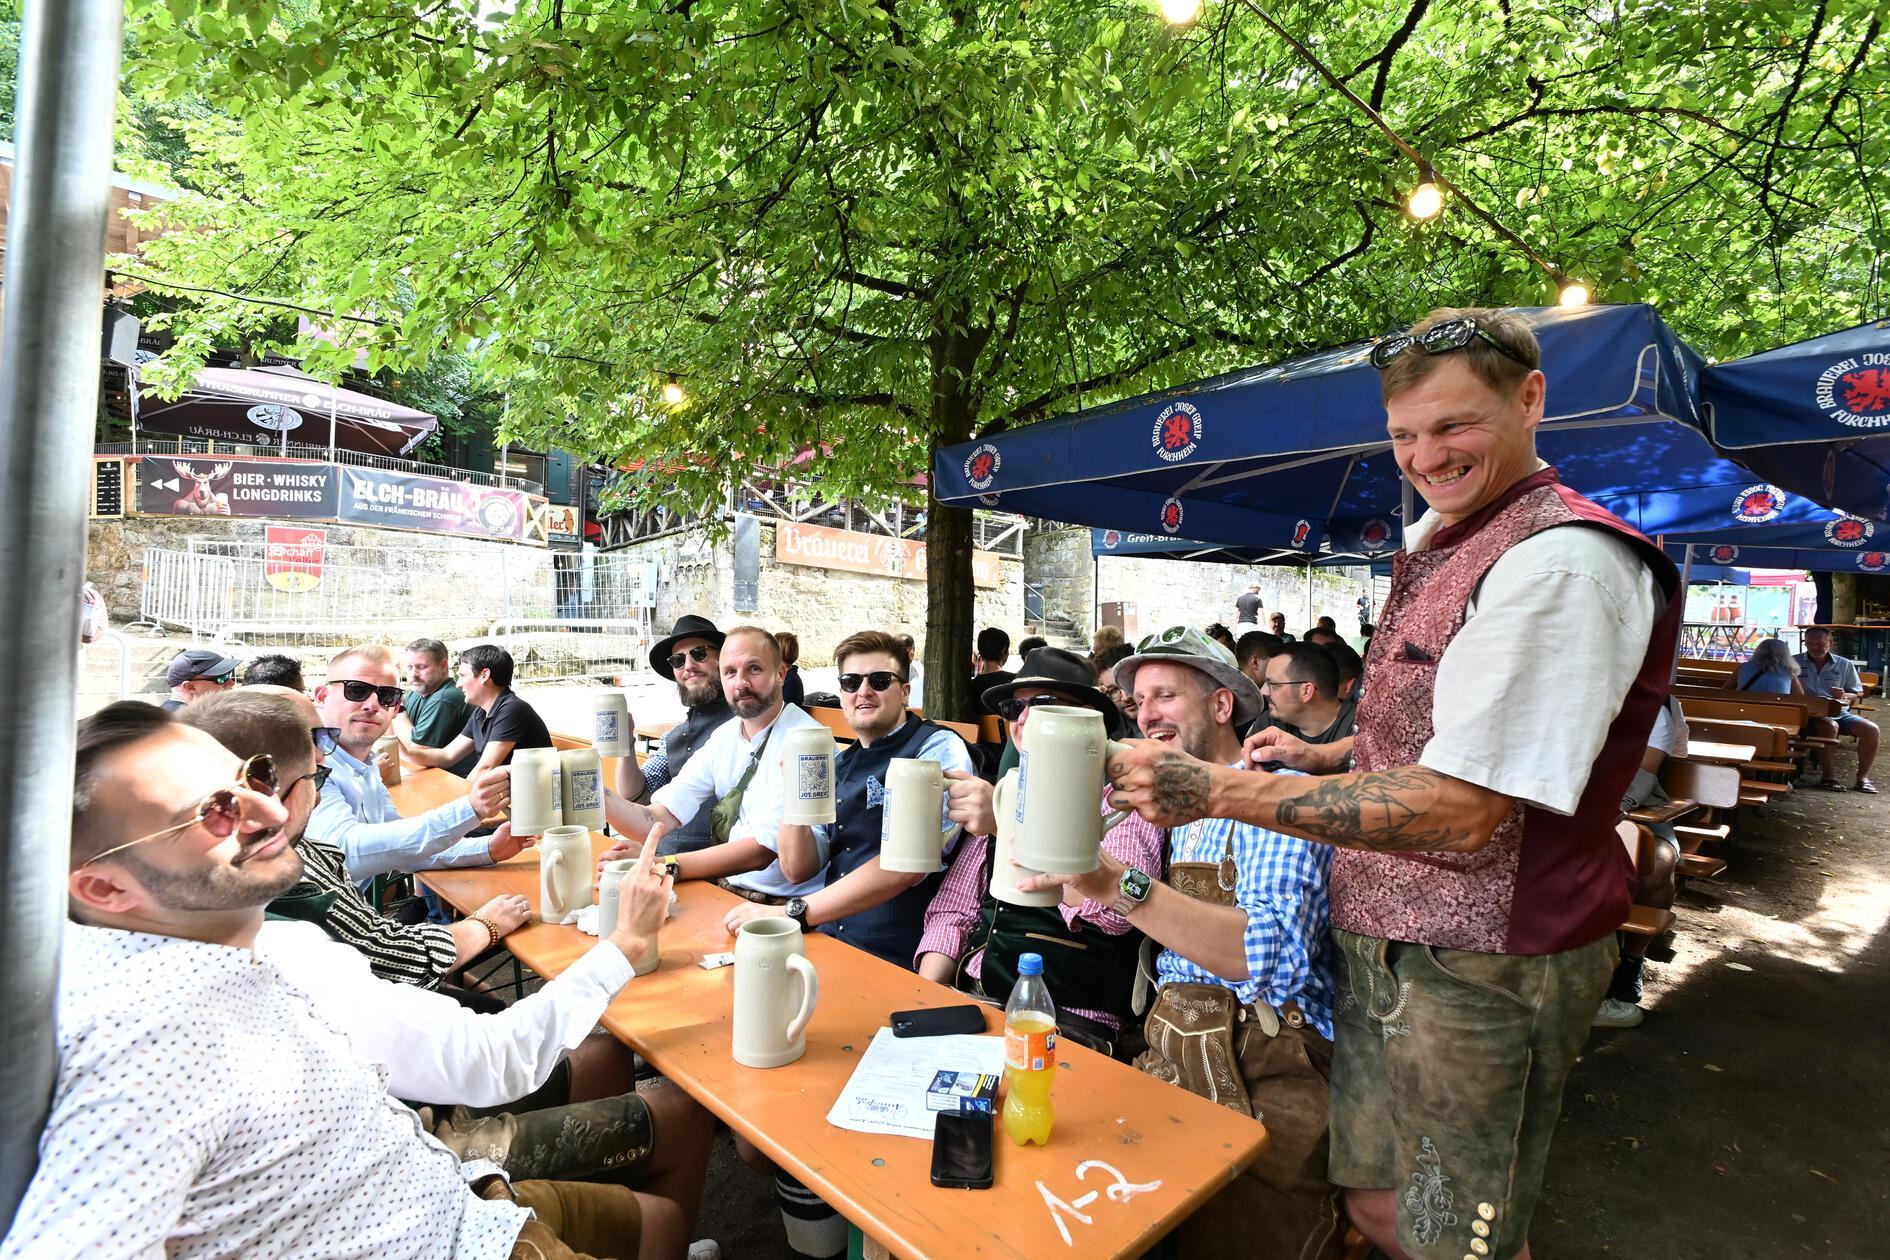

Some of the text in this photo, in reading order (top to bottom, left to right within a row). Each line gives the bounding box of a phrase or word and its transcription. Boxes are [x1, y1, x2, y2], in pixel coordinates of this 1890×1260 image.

[1816, 353, 1890, 410] BRAUEREI JOS
[1152, 402, 1202, 447] BRAUEREI JOSEF GREIF
[1829, 409, 1890, 428] FORCHH
[1157, 442, 1197, 461] FORCHHEIM
[233, 473, 328, 488] BIER WHISKY
[233, 488, 322, 502] LONGDRINKS
[353, 480, 464, 513] ELCH-BRÄU
[353, 502, 369, 510] AUS
[369, 505, 384, 513] DER
[384, 506, 432, 519] FRÄNKISCHEN
[784, 526, 870, 564] Brauerei
[1034, 1159, 1163, 1247] 1-2
